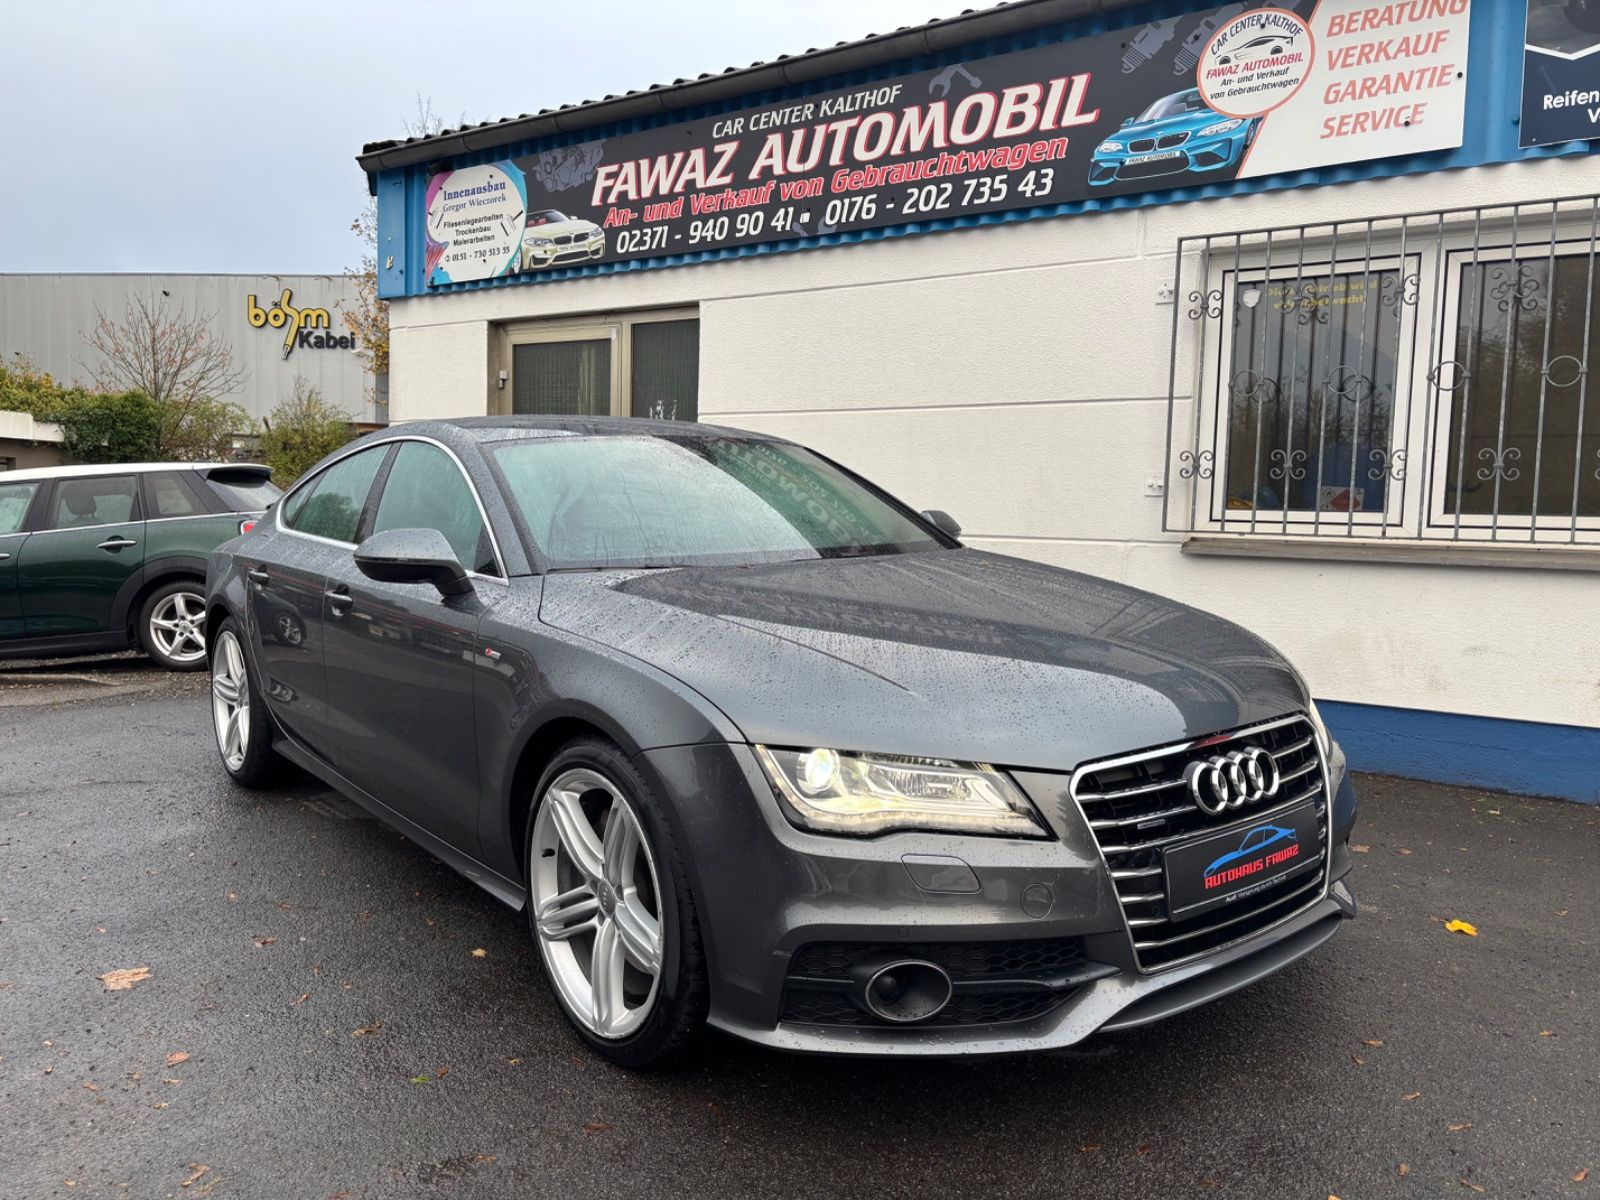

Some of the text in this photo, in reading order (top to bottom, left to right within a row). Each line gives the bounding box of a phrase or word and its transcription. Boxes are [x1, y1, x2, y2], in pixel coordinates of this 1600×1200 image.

[1210, 13, 1304, 56] CAR CENTER KALTHOF
[1326, 0, 1469, 38] BERATUNG
[1206, 52, 1304, 80] FAWAZ AUTOMOBIL
[1327, 29, 1450, 71] VERKAUF
[1210, 78, 1300, 100] von Gebrauchtwagen
[1220, 66, 1290, 87] An- und Verkauf
[1323, 64, 1455, 105] GARANTIE
[712, 84, 903, 138] CAR CENTER KALTHOF
[1320, 102, 1428, 139] SERVICE
[591, 73, 1100, 206] FAWAZ AUTOMOBIL
[443, 180, 506, 201] Innenausbau
[603, 137, 1068, 229] An- und Verkauf von Gebrauchtwagen
[443, 193, 507, 213] Gregor Wieczorek
[616, 225, 669, 254] 02371
[688, 216, 729, 244] 940
[735, 211, 764, 237] 90
[770, 207, 795, 231] 41
[825, 193, 877, 225] 0176
[902, 183, 953, 214] 202
[961, 174, 1008, 206] 735
[1017, 168, 1054, 197] 43
[443, 213, 504, 229] Fliesenlegearbeiten
[455, 225, 491, 236] Trockenbau
[453, 234, 495, 246] Malerarbeiten
[474, 249, 487, 258] 730
[298, 331, 355, 349] Kabel
[1204, 844, 1299, 890] AUTOHAUS FAWAZ
